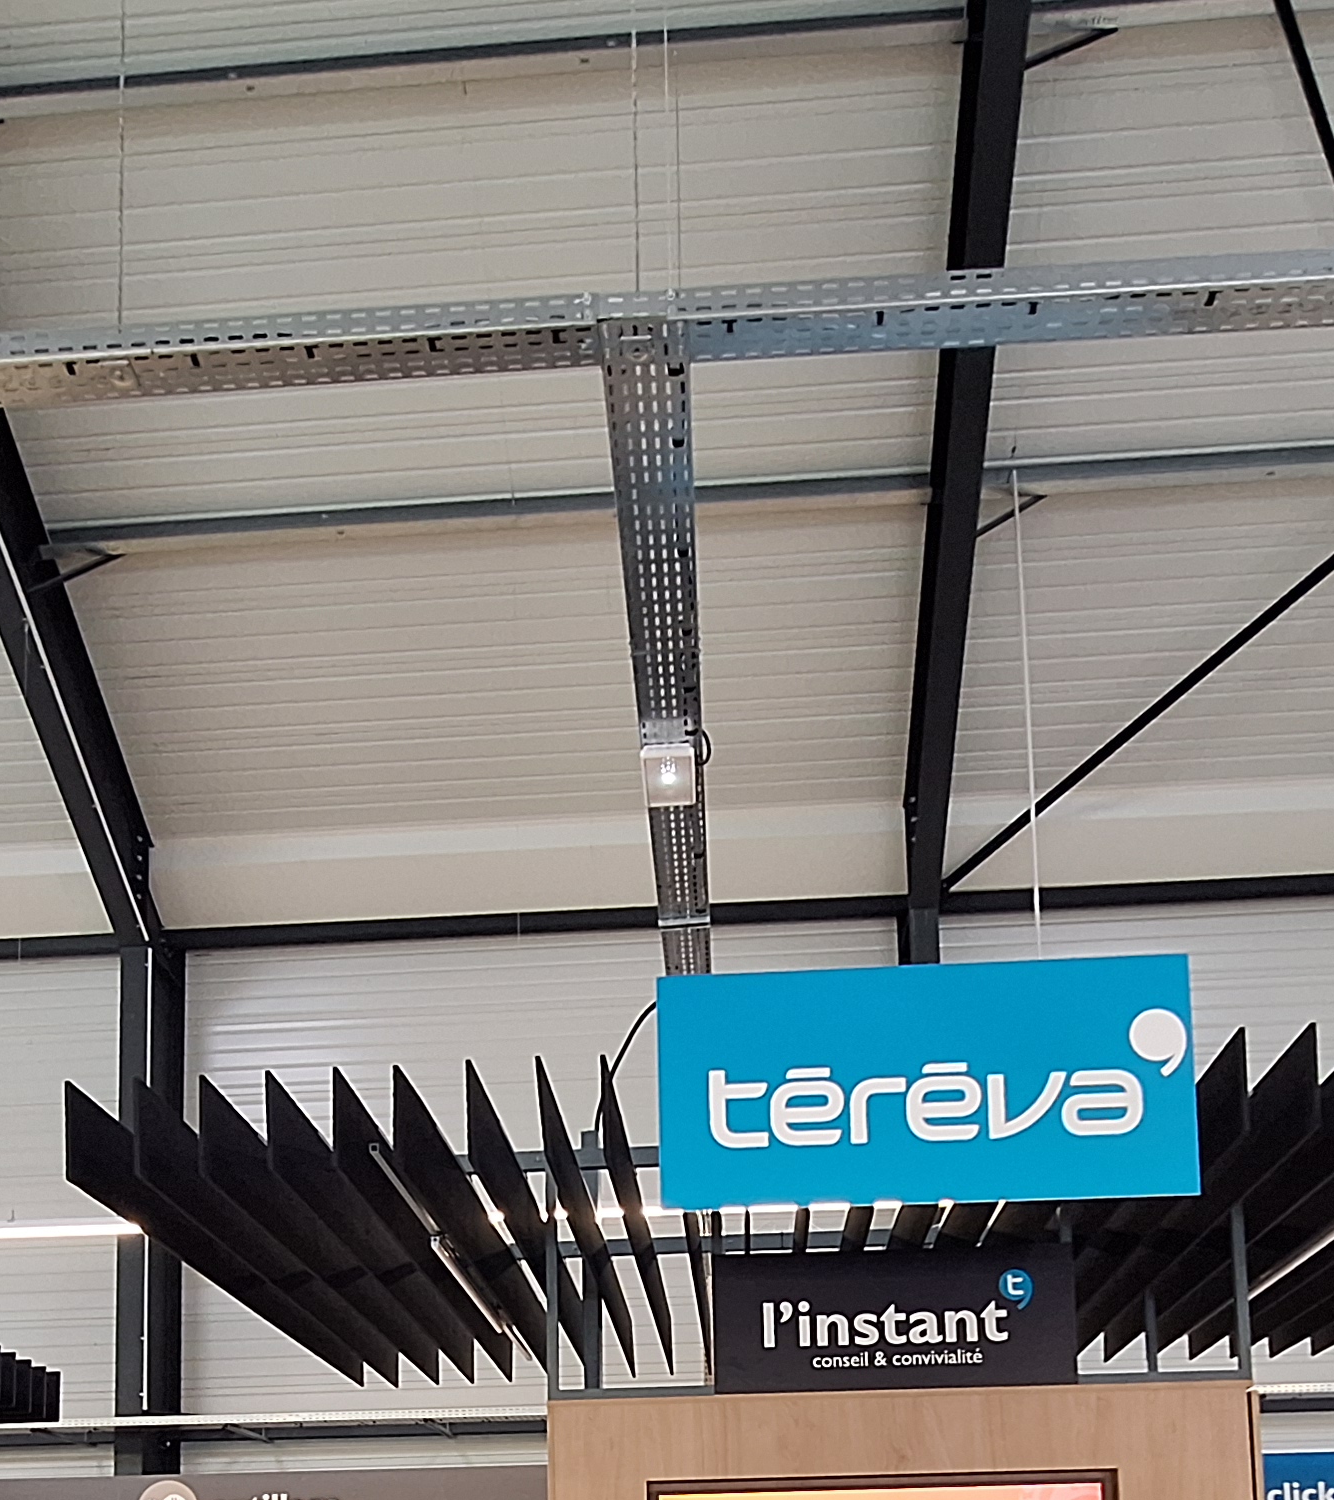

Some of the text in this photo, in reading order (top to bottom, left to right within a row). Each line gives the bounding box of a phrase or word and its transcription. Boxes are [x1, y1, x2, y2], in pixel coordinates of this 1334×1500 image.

[762, 1300, 1009, 1348] l'instant
[812, 1348, 983, 1369] conseil & convivialité
